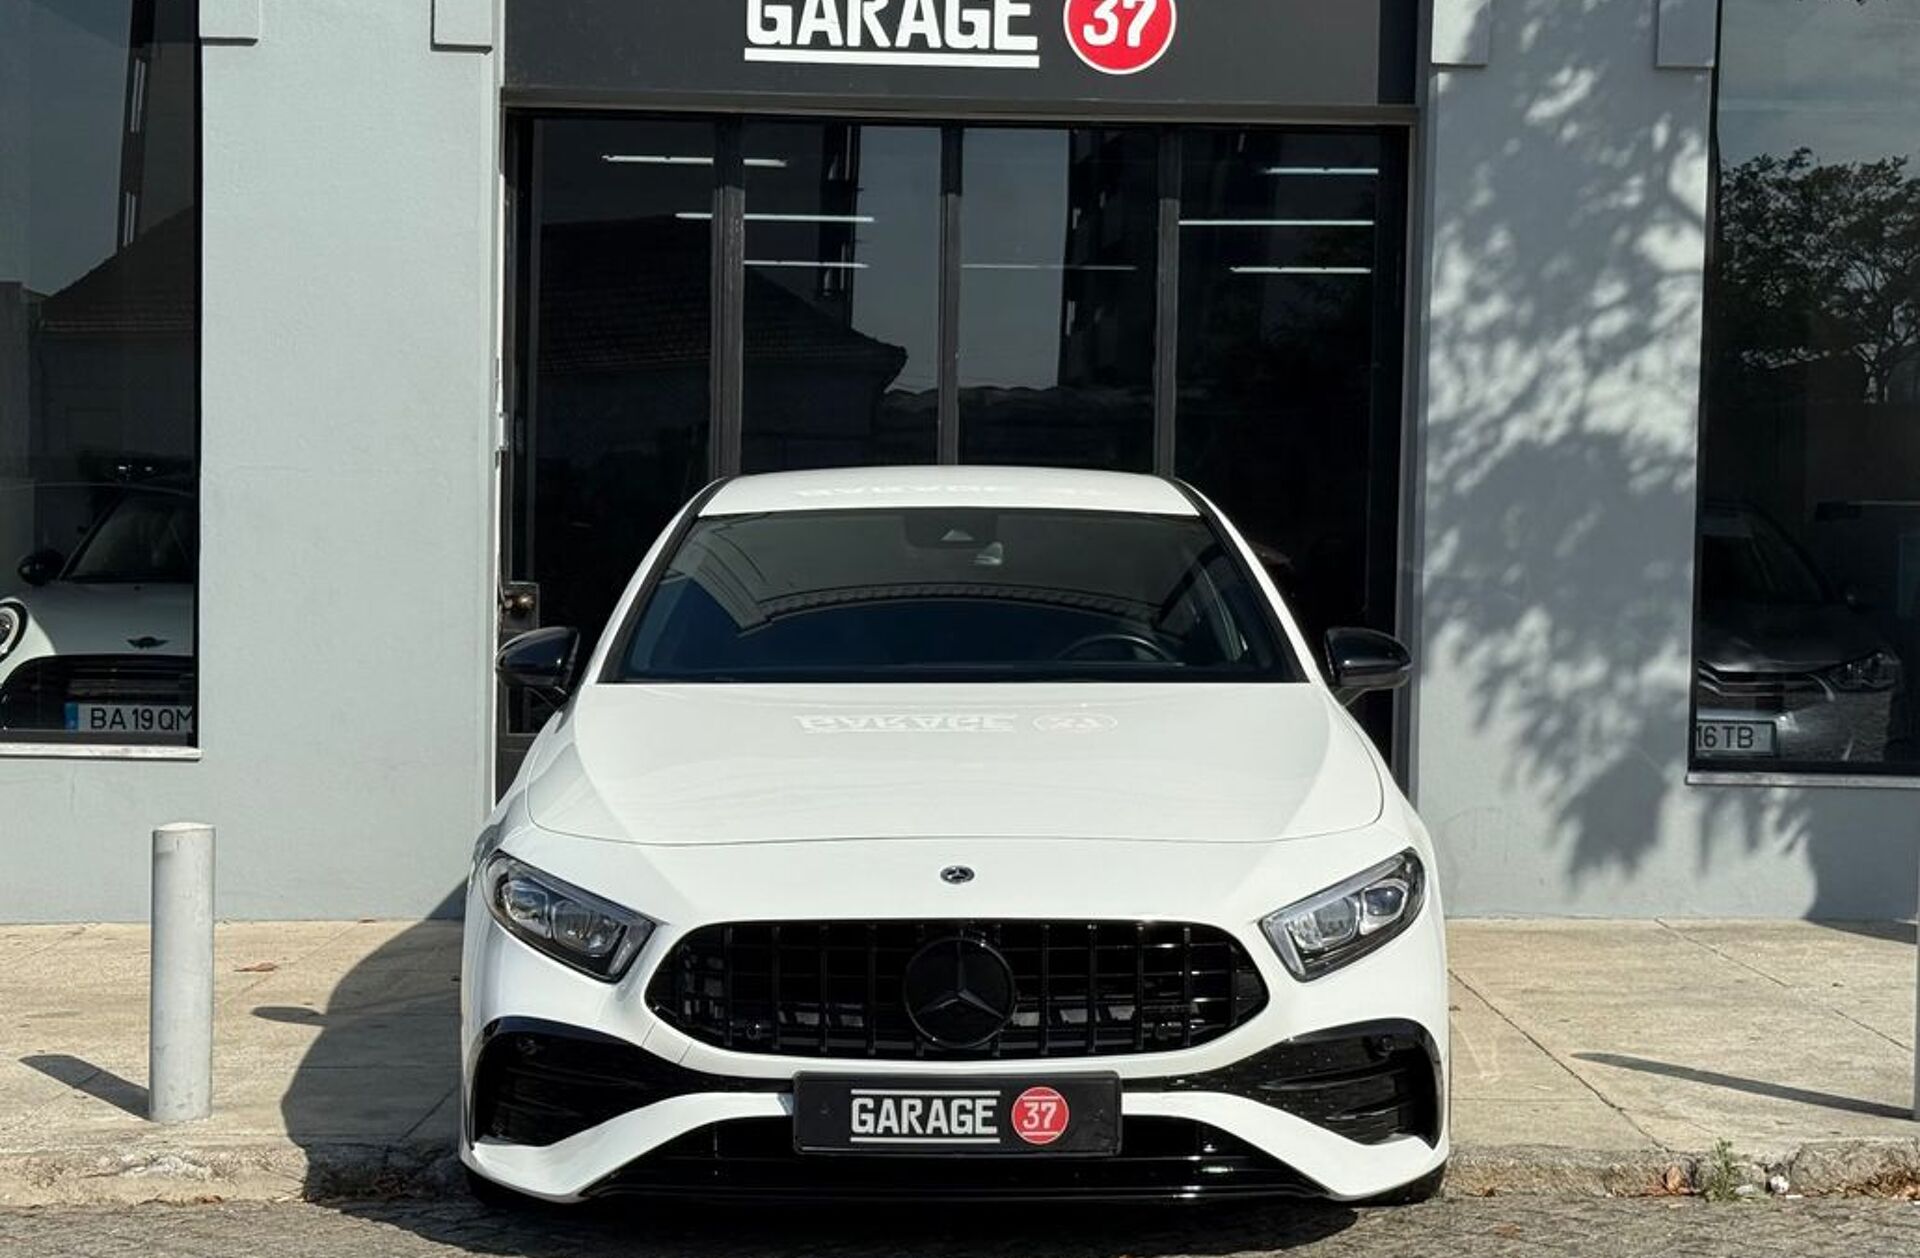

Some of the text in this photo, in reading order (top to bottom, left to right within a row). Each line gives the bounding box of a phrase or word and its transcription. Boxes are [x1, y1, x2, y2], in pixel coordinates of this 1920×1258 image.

[746, 0, 1157, 50] GARAGE 37
[90, 707, 126, 730] BA
[131, 708, 154, 730] 19
[1695, 725, 1754, 749] 16 TB
[850, 1097, 1058, 1135] GARAGE 37
